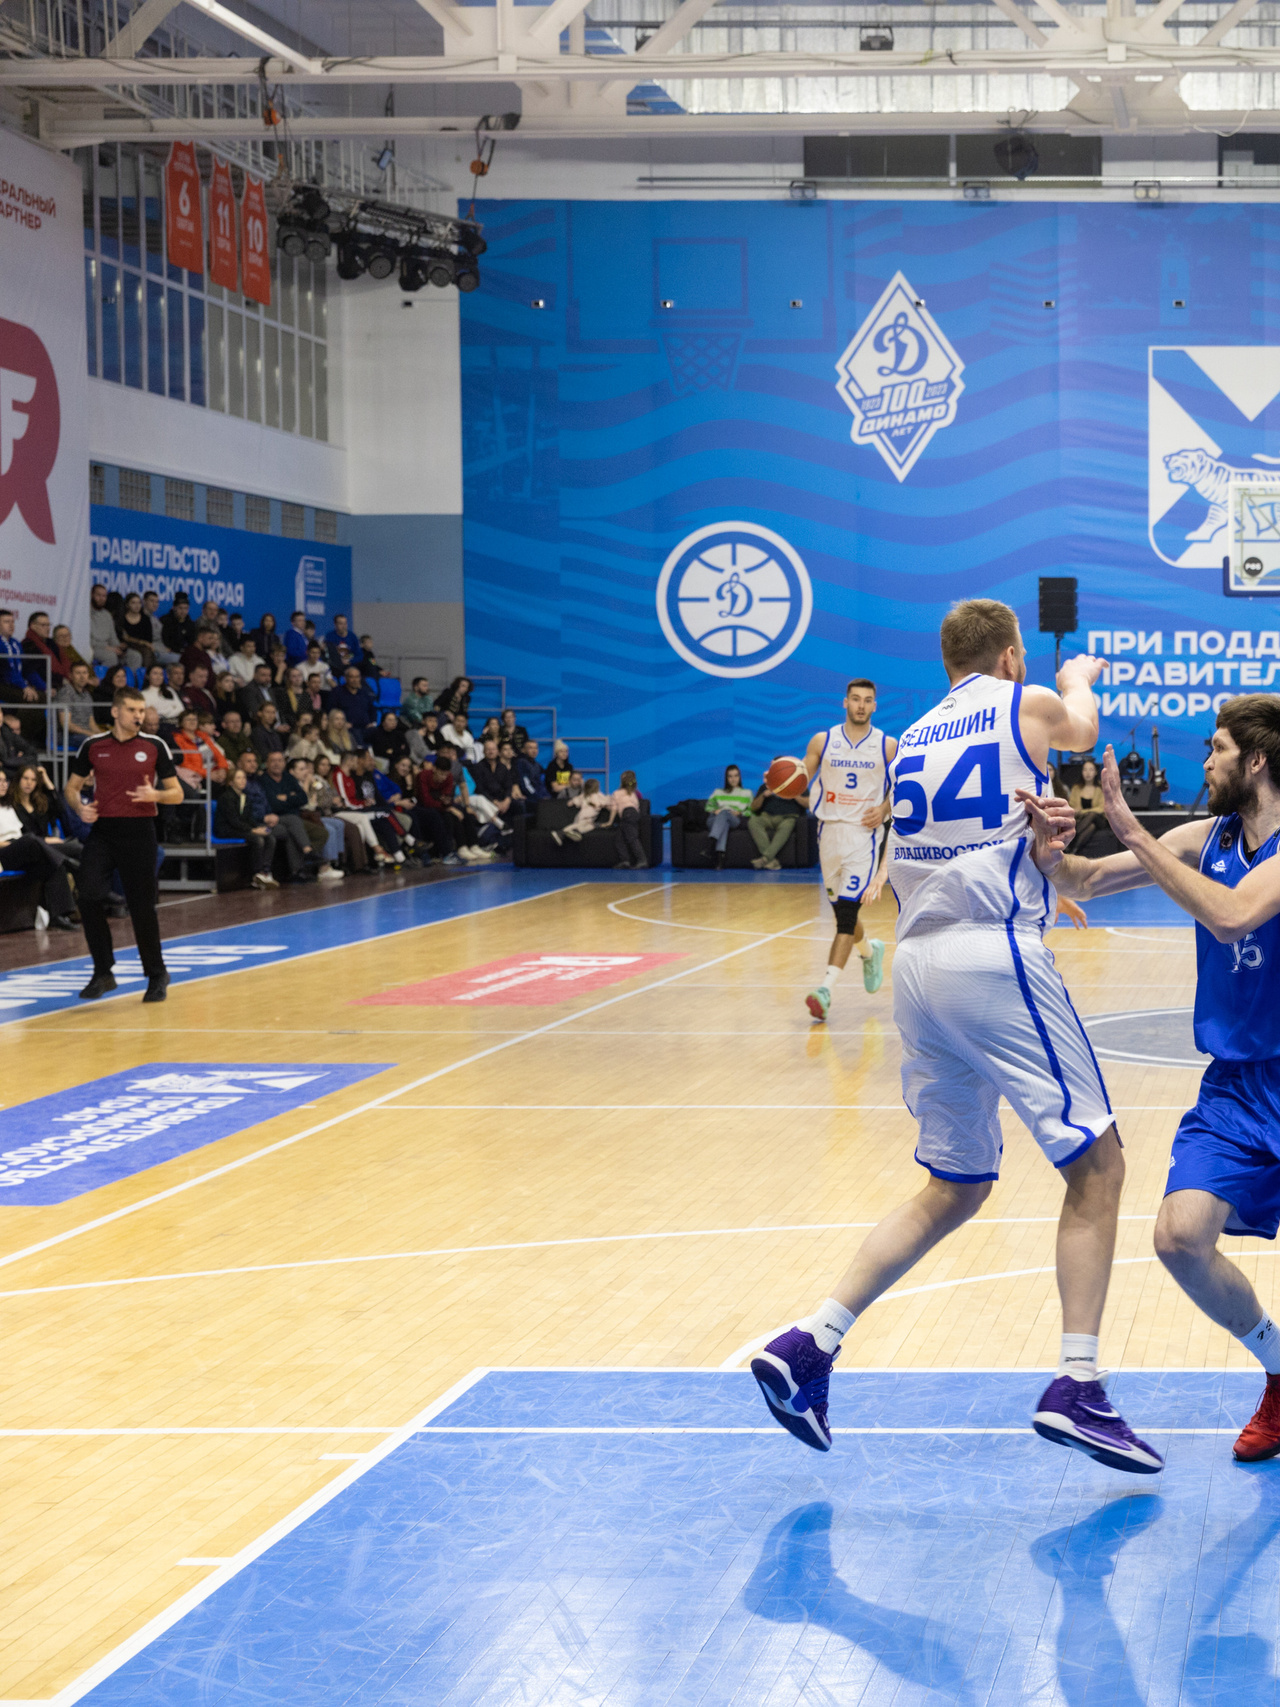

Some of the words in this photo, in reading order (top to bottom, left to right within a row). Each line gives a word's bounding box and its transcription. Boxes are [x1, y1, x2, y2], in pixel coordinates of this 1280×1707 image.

[0, 178, 56, 219] РАЛЬНЫЙ
[178, 181, 191, 217] 6
[0, 200, 42, 231] АРТНЕР
[216, 201, 231, 239] 11
[247, 216, 263, 252] 10
[866, 380, 945, 417] 100
[860, 403, 948, 435] ДИНАМО
[891, 426, 914, 437] ЛЕТ
[90, 534, 220, 575] ПРАВИТЕЛЬСТВО
[207, 581, 244, 607] КРАЯ
[1088, 631, 1162, 655] ПРИ
[830, 759, 875, 770] ДИНАМО
[845, 773, 858, 789] 3
[892, 742, 1009, 836] 54
[846, 875, 860, 891] 3
[0, 1096, 199, 1171] ПРИМОРСКОГ
[824, 1322, 846, 1337] DEM
